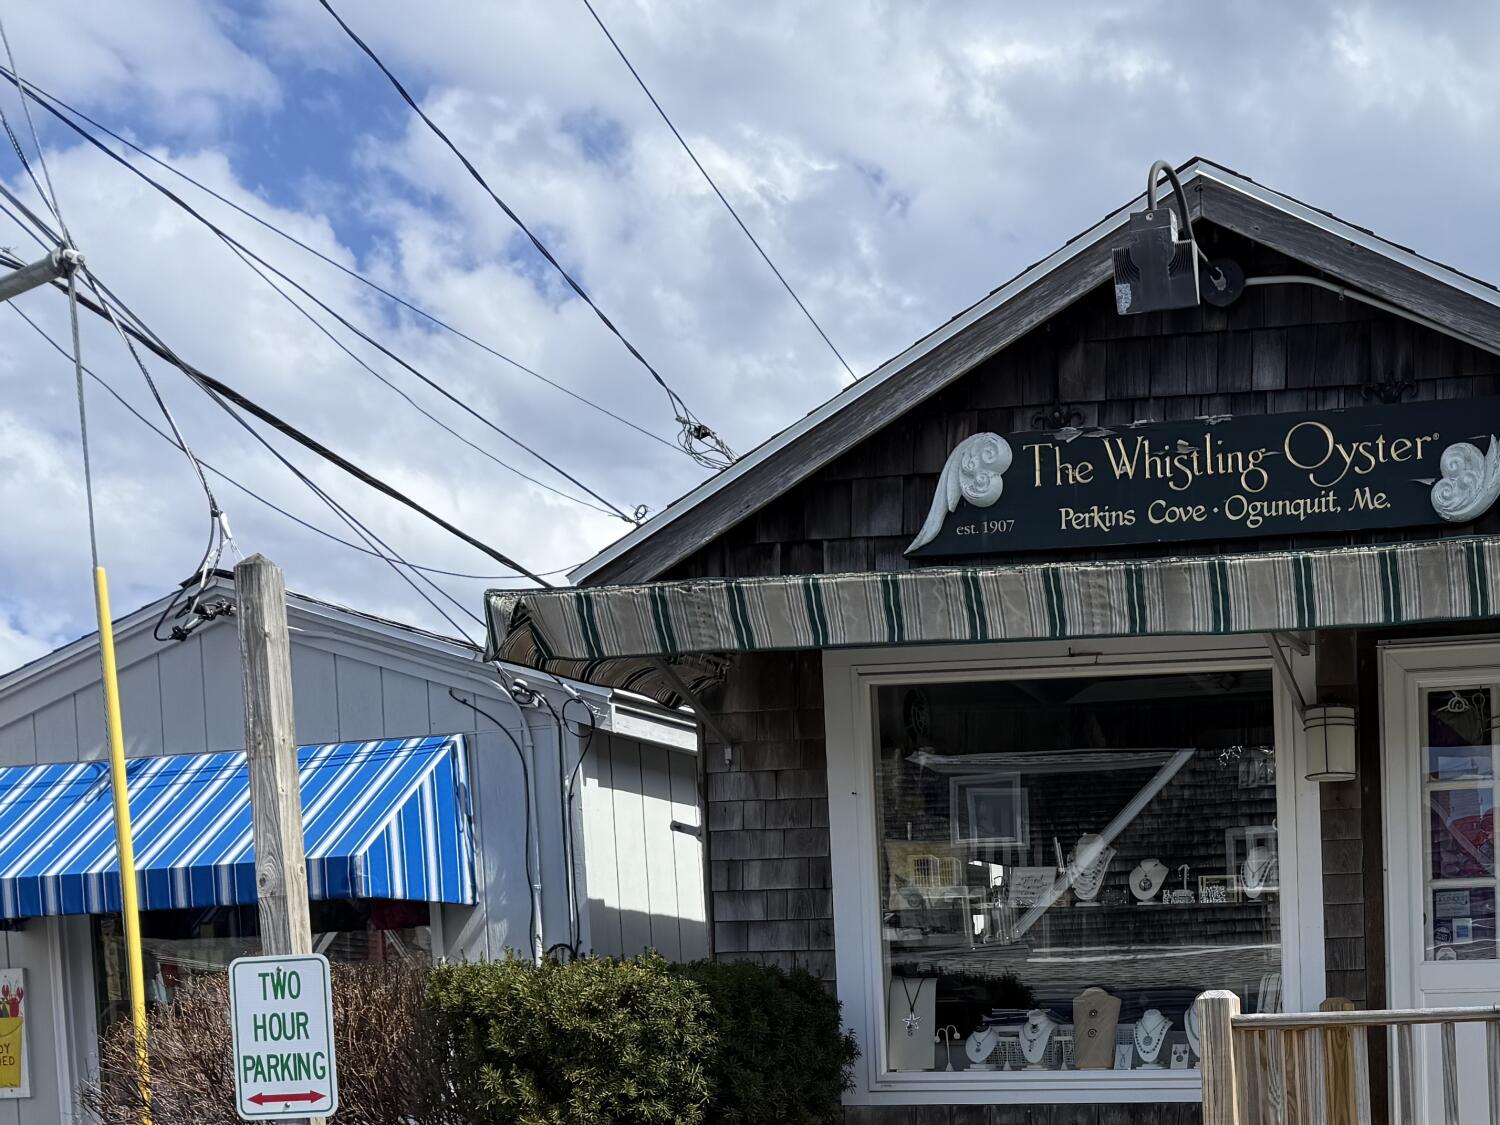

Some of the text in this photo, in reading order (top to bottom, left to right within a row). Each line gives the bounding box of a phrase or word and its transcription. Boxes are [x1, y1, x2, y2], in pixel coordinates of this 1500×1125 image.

[1022, 442, 1095, 488] The
[1103, 432, 1283, 493] Whistling
[1058, 486, 1391, 532] Perkins Cove Ogunquit, Me.
[956, 519, 1015, 536] est. 1907
[258, 970, 301, 1001] TWO
[253, 1011, 310, 1042] HOUR
[242, 1051, 327, 1084] PARKING
